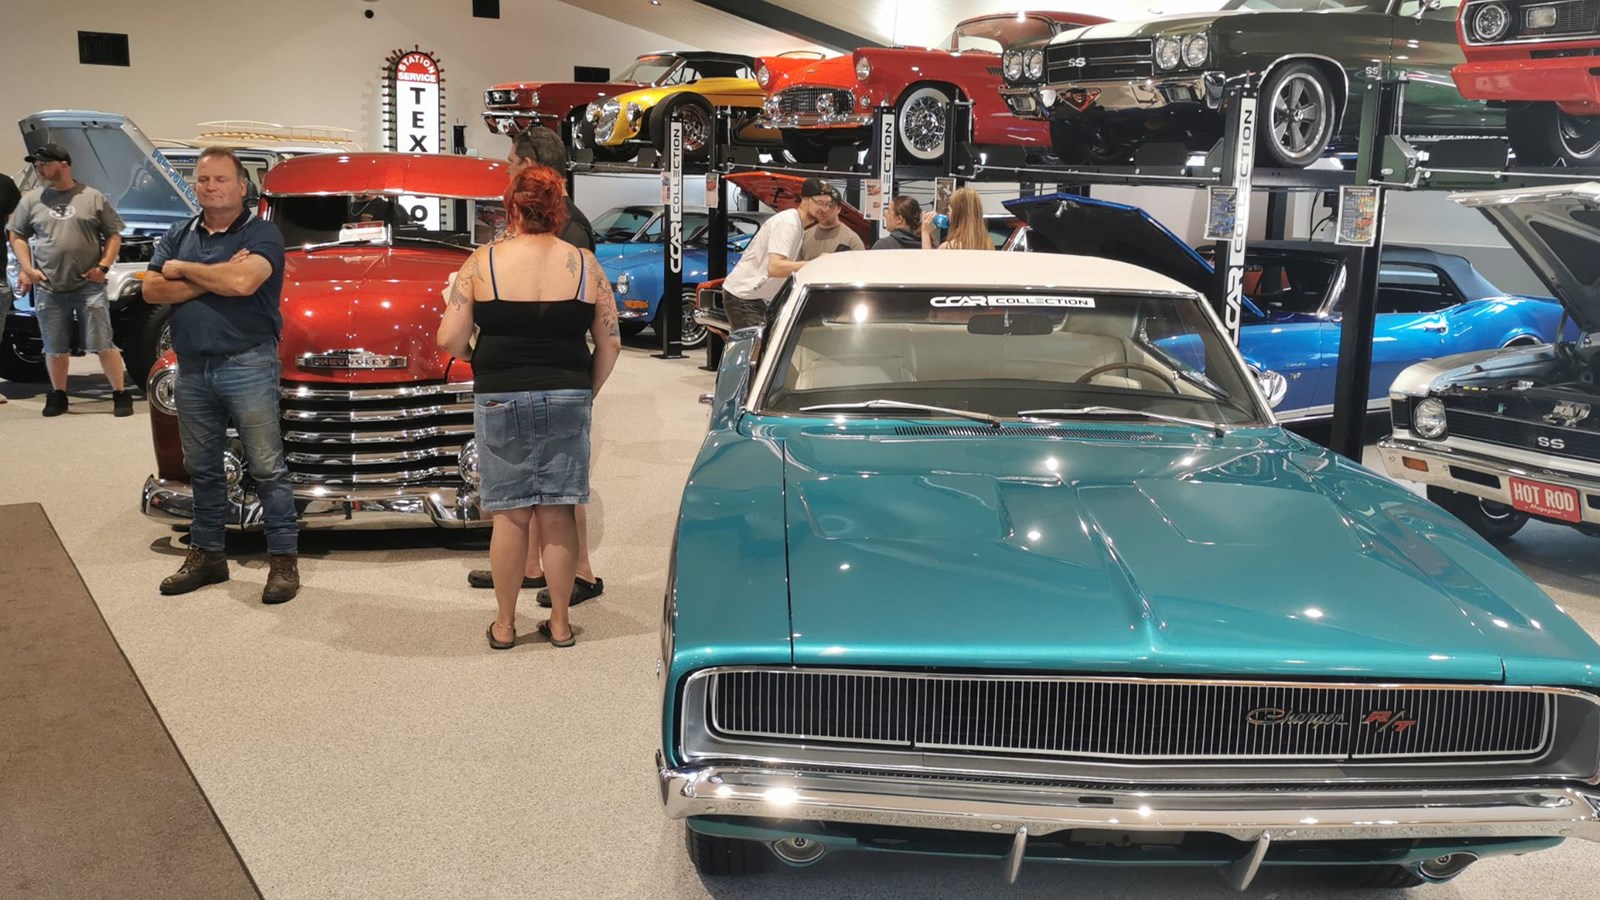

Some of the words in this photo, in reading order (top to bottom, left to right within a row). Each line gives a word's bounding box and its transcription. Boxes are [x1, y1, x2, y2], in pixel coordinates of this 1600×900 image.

[399, 54, 436, 75] STATION
[1068, 57, 1087, 67] SS
[398, 72, 437, 83] SERVICE
[409, 86, 428, 222] TEXO
[672, 128, 681, 215] COLLECTION
[1235, 109, 1253, 254] COLLECTION
[670, 221, 682, 274] CCAR
[930, 296, 987, 307] CCAR
[995, 296, 1089, 307] COLLECTION
[1537, 436, 1565, 449] SS
[1512, 482, 1540, 504] HOT
[1544, 488, 1575, 512] ROD
[1529, 503, 1563, 516] Magazine
[1246, 707, 1348, 729] Charger
[1364, 710, 1416, 733] R/T
